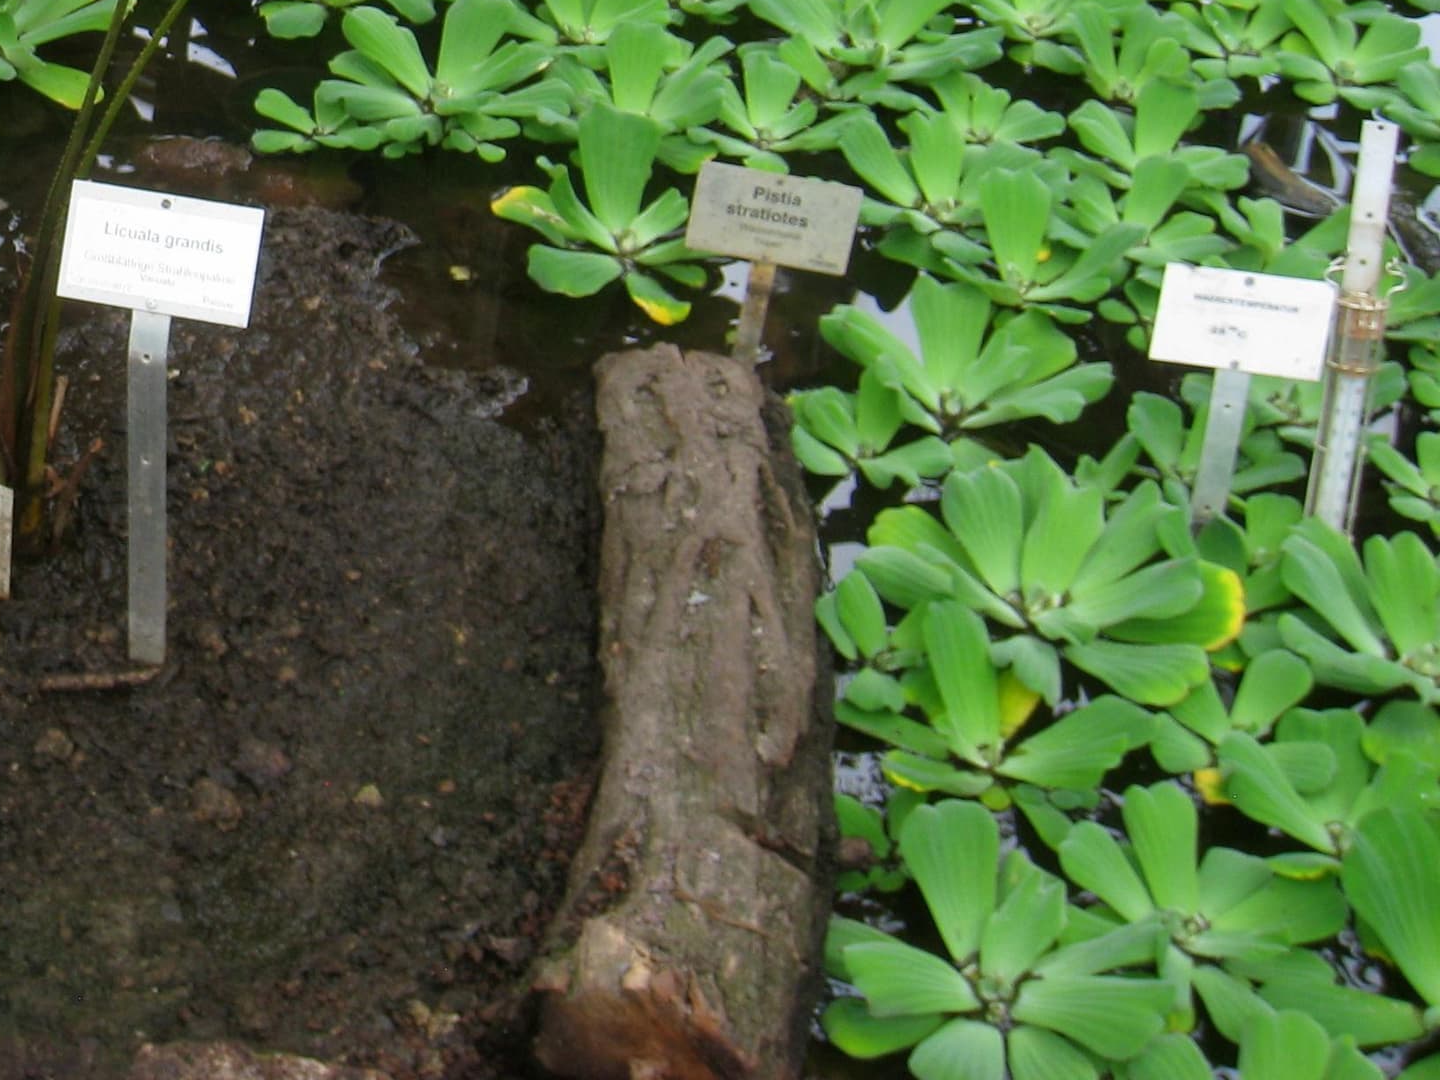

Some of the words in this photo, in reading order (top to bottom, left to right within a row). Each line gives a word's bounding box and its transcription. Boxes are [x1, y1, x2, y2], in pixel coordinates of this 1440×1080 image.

[752, 186, 803, 207] Pistia
[726, 203, 809, 229] stratiotes
[104, 221, 160, 244] Licuala
[165, 233, 224, 255] grandis
